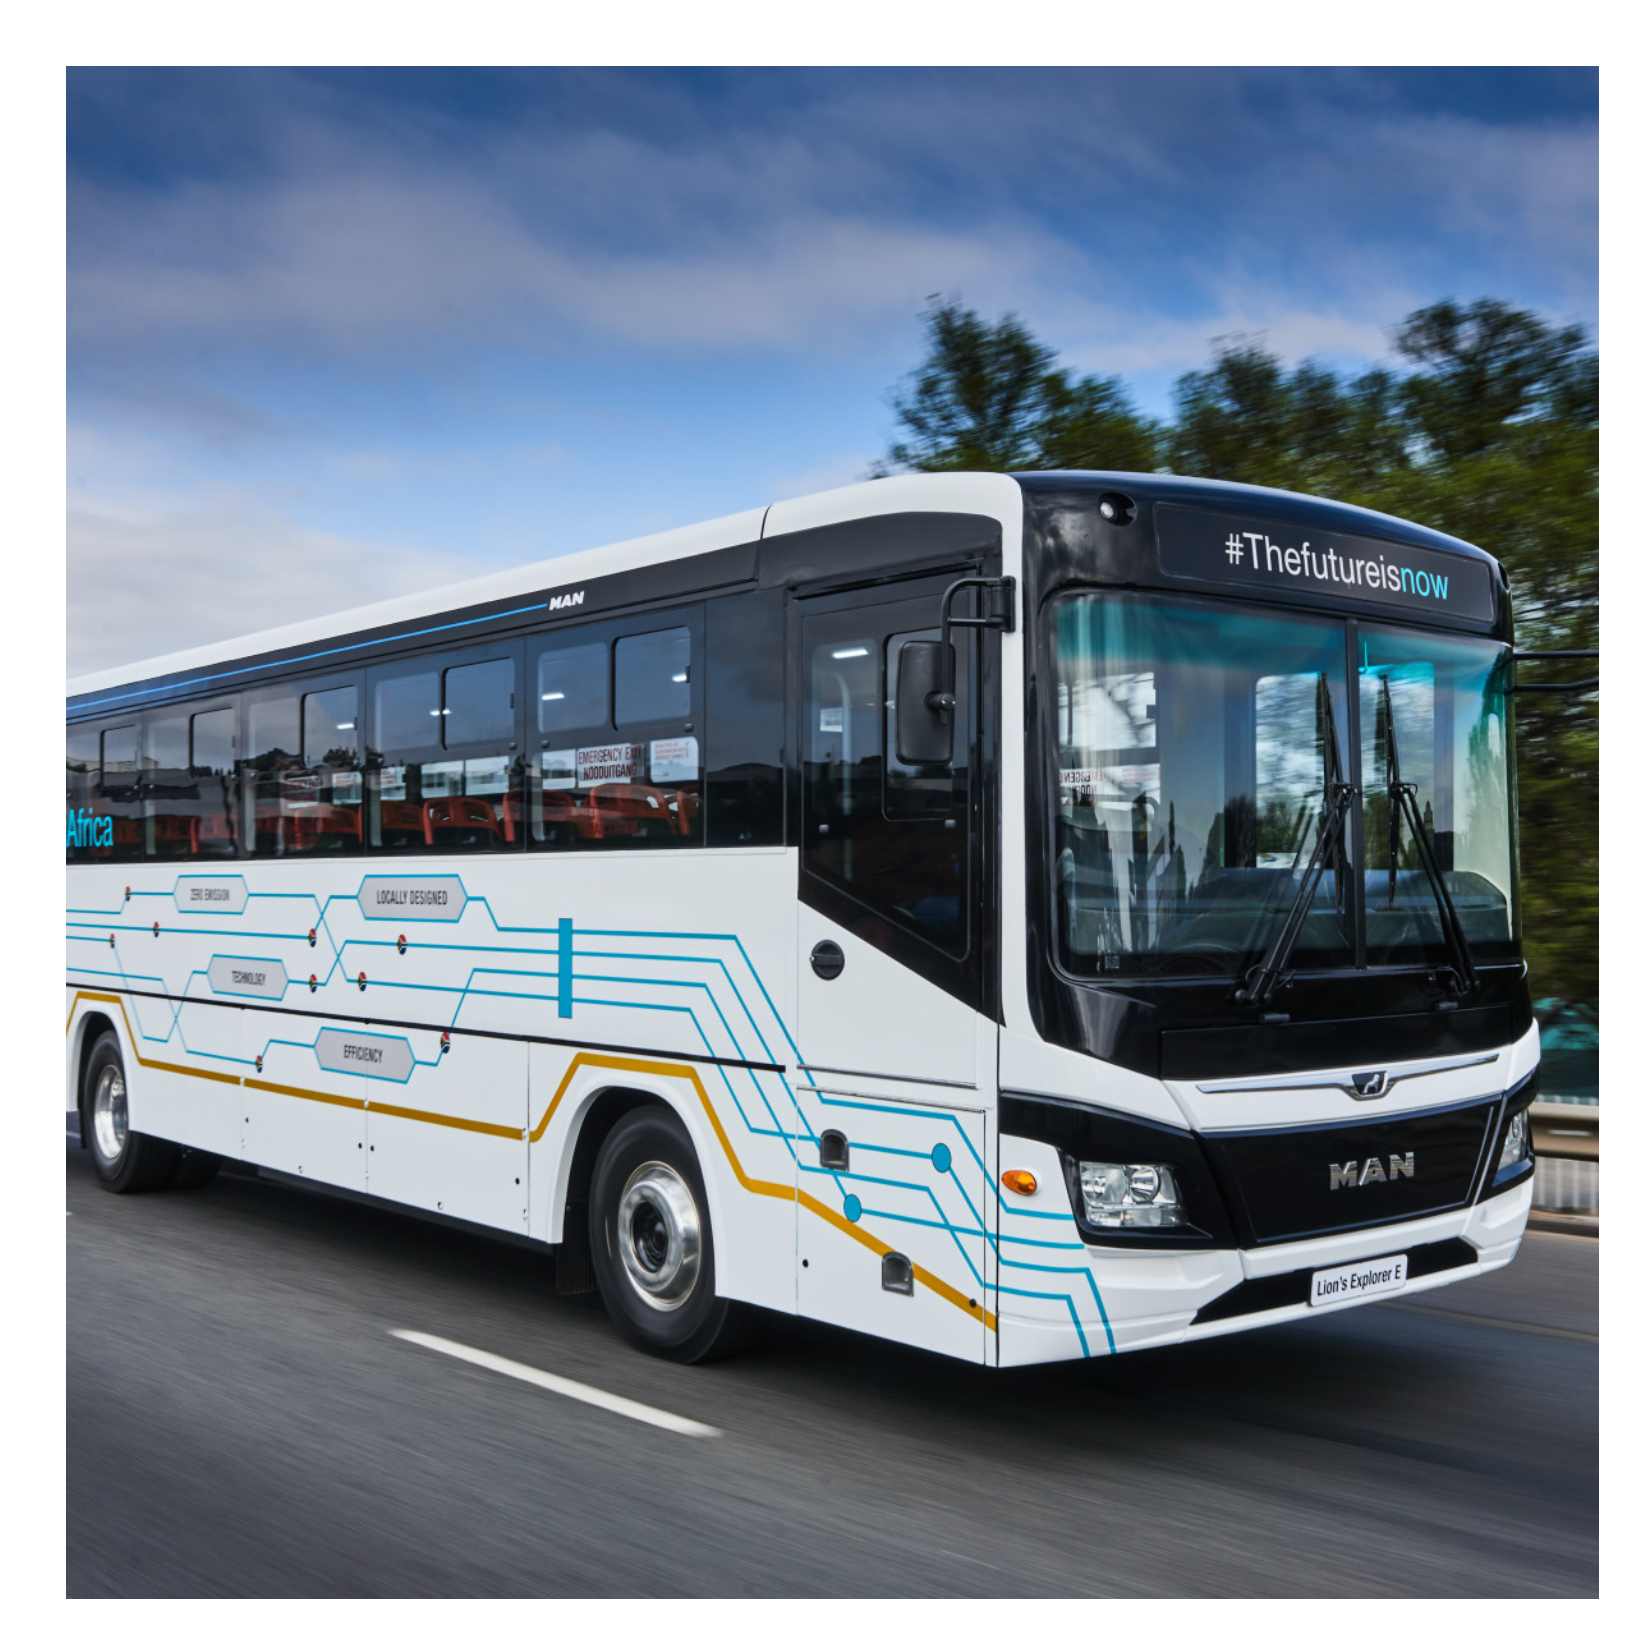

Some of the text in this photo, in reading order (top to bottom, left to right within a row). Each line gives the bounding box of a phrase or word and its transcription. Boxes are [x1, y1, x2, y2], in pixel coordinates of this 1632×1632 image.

[1225, 532, 1448, 600] #Thefutureisnow
[549, 591, 585, 611] MAN
[66, 807, 113, 847] Africa
[376, 889, 448, 905] LOCALLY DESIGNED
[343, 1044, 384, 1064] EFFICIENCY
[1329, 1152, 1415, 1190] MAN
[1317, 1264, 1402, 1296] Lion's Explorer E
